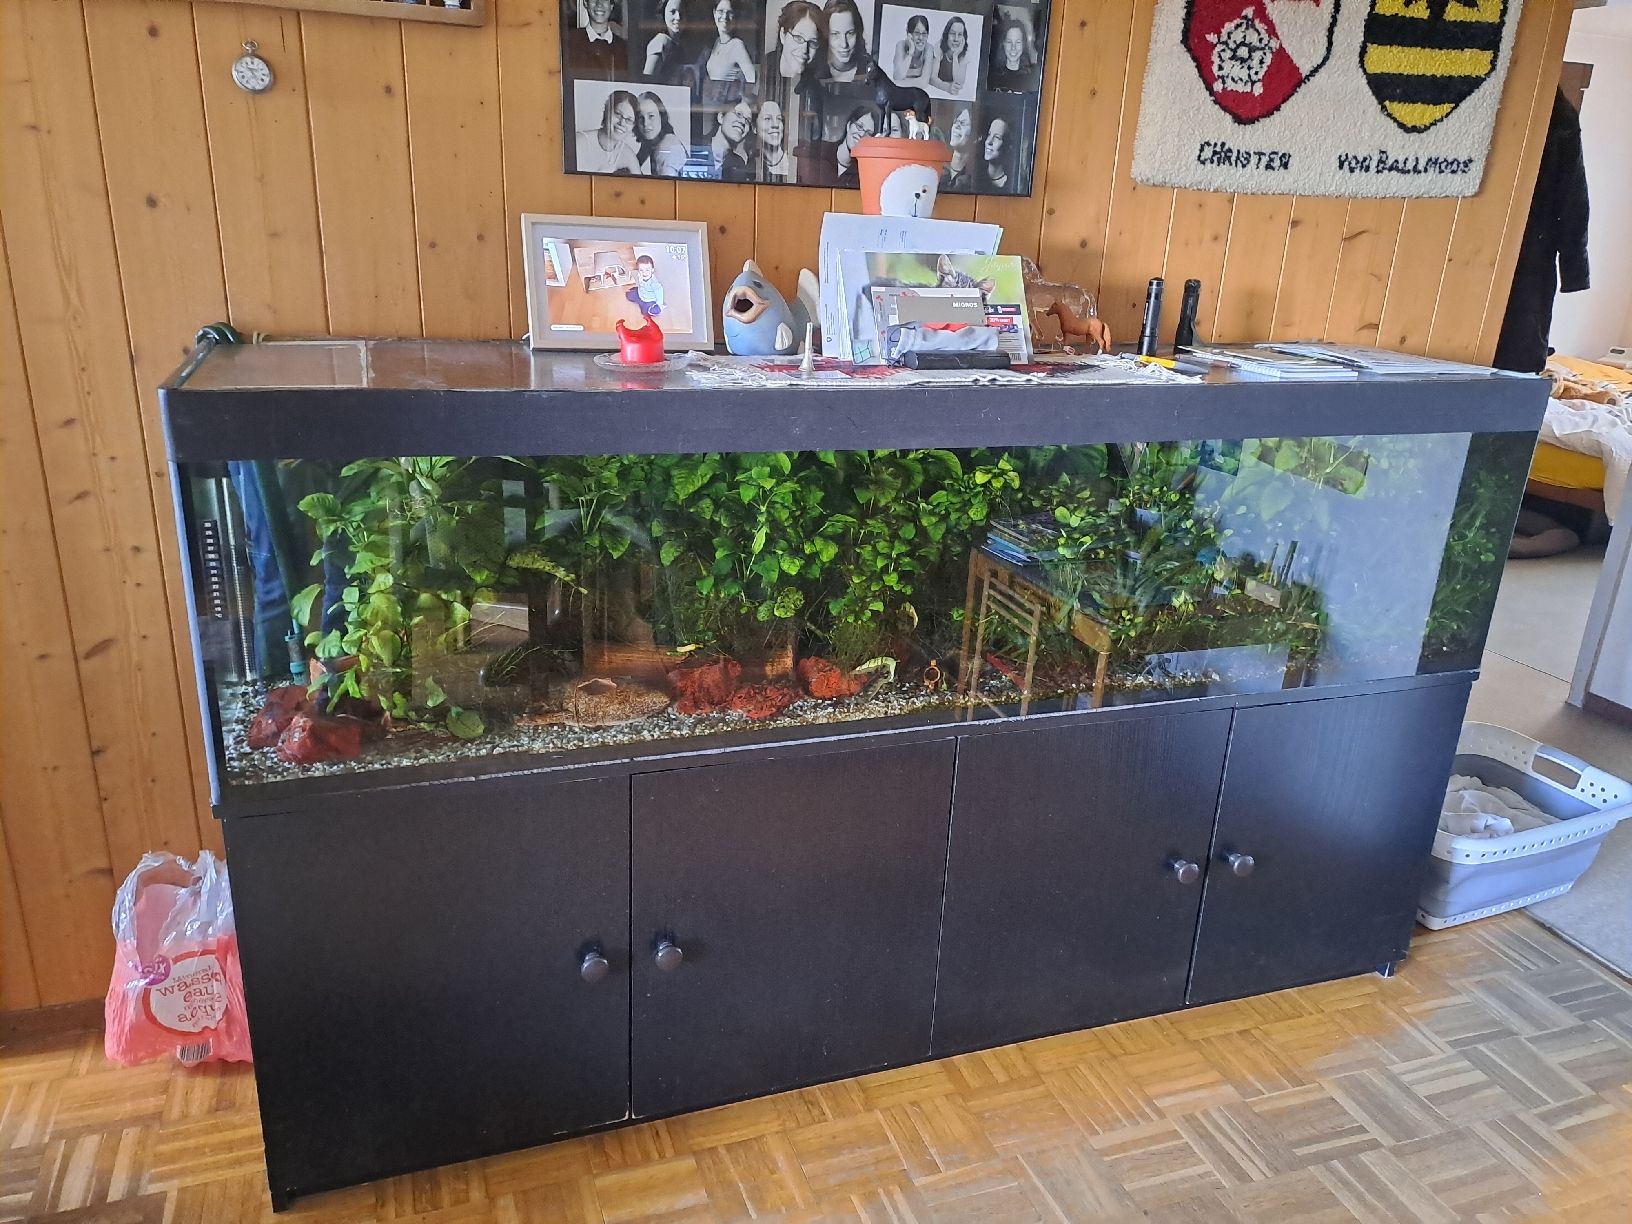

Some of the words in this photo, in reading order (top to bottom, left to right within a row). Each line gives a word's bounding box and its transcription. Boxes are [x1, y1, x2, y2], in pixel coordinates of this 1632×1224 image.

[1197, 141, 1292, 171] CHRISTEN
[1338, 153, 1372, 173] VON
[665, 245, 686, 254] 10:07
